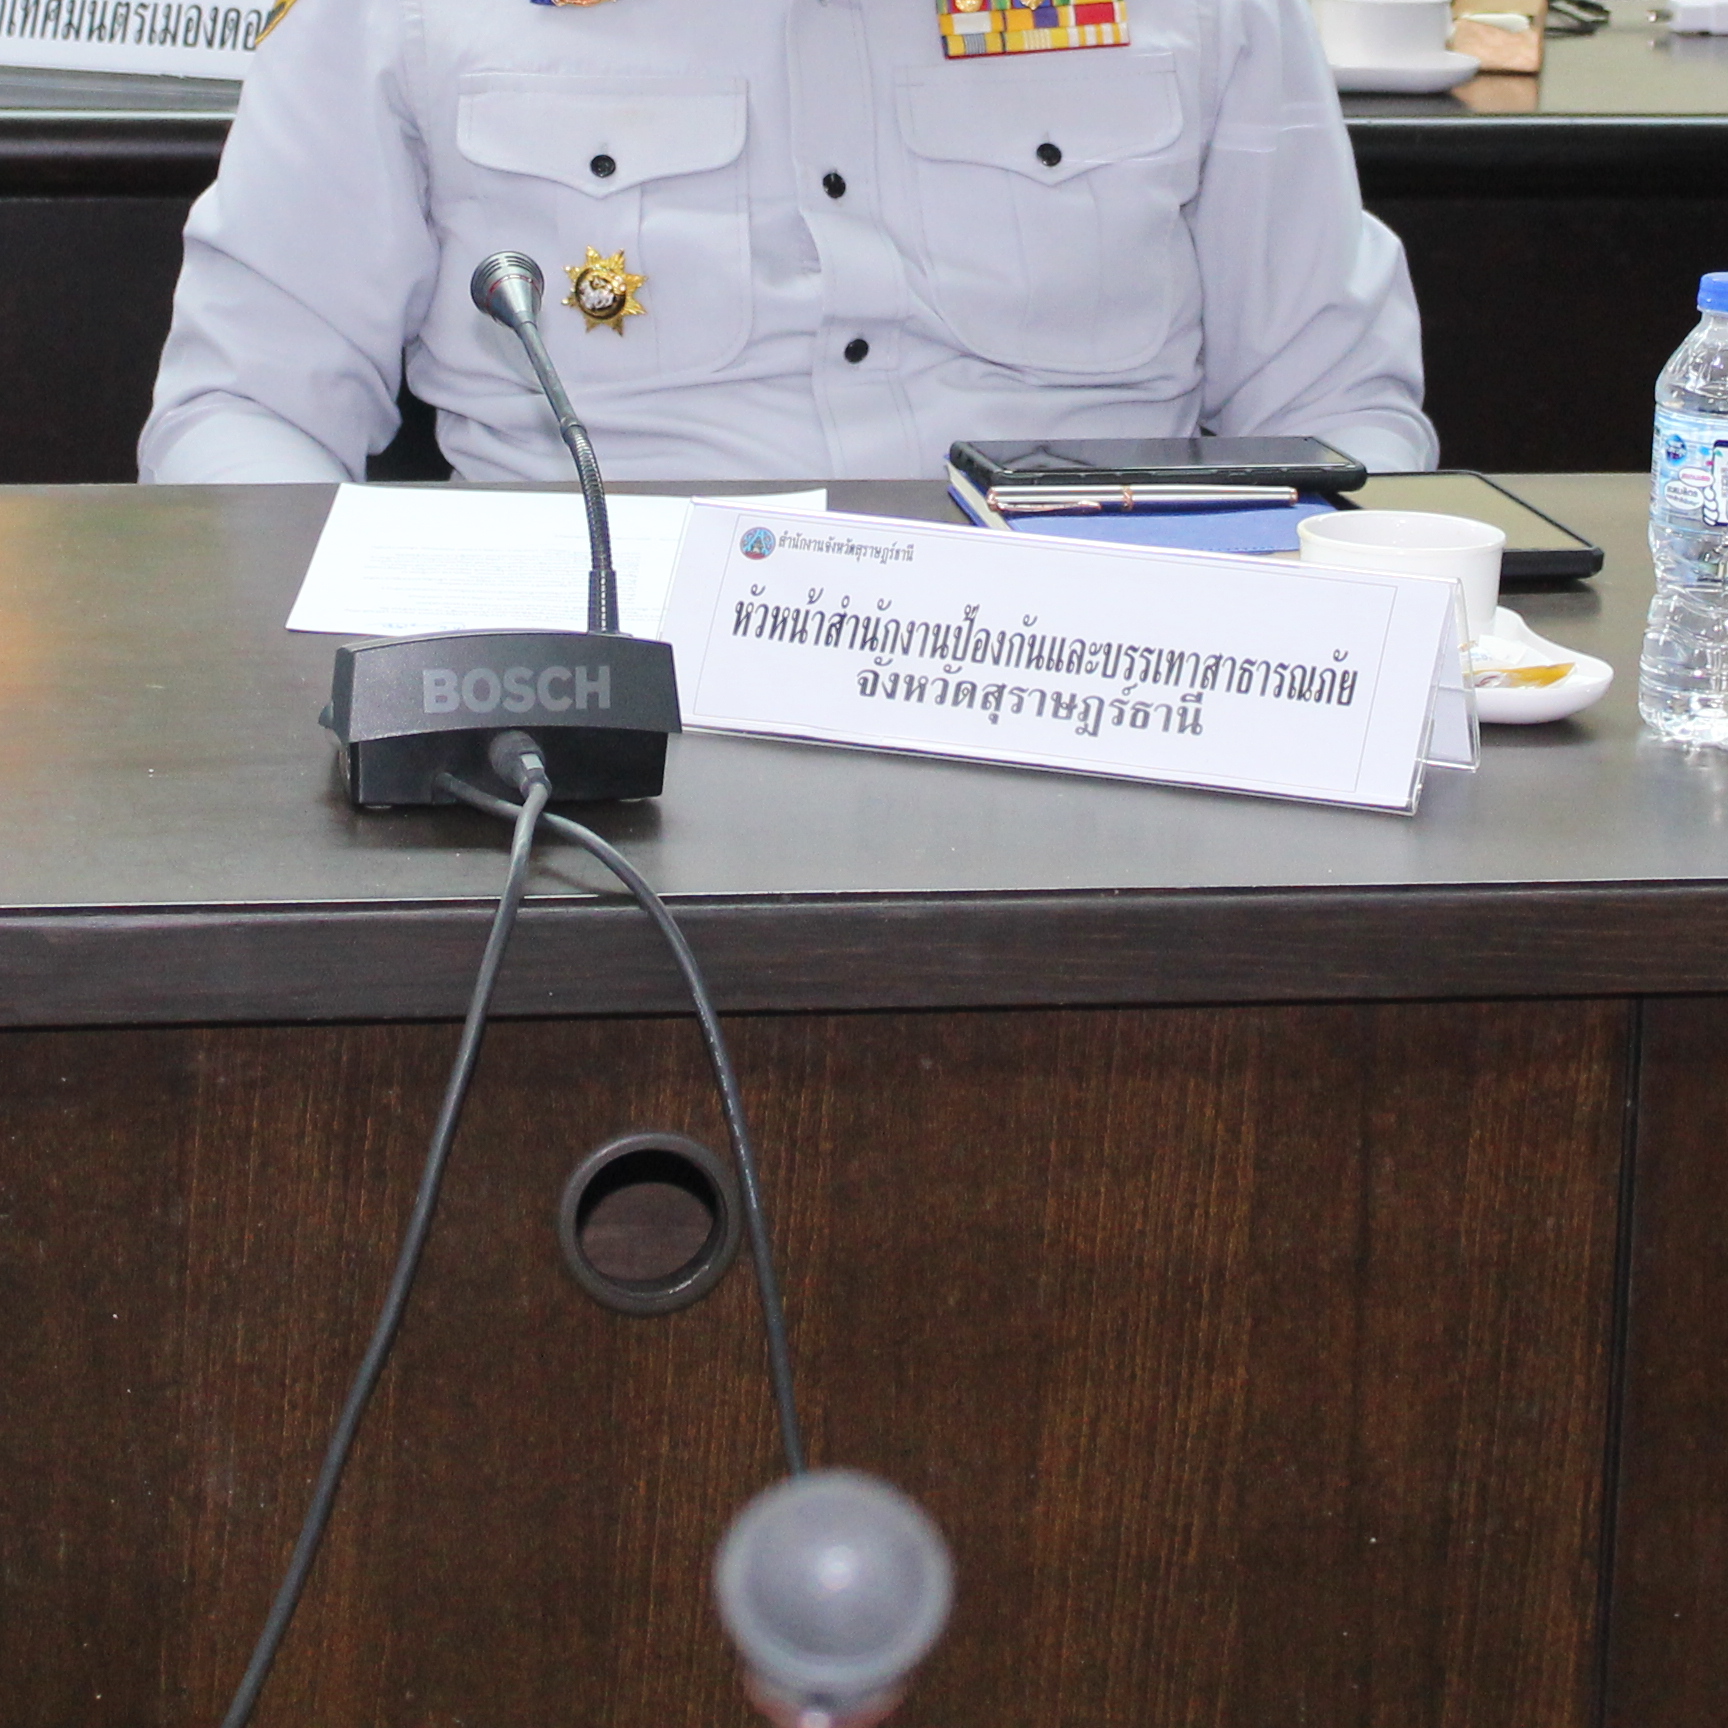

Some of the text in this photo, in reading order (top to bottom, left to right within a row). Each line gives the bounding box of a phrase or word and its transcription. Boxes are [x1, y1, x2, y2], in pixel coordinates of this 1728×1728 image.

[778, 530, 915, 564] สำนักงานจังหวัดสุราษฎร์ธานี
[732, 583, 1358, 706] หัวหน้าสำนักงานป้องกันและบรรเทาสาธารณภัย
[423, 665, 611, 714] BOSCH
[856, 656, 1204, 737] จังหวัดสุราษฎร์ธานี
